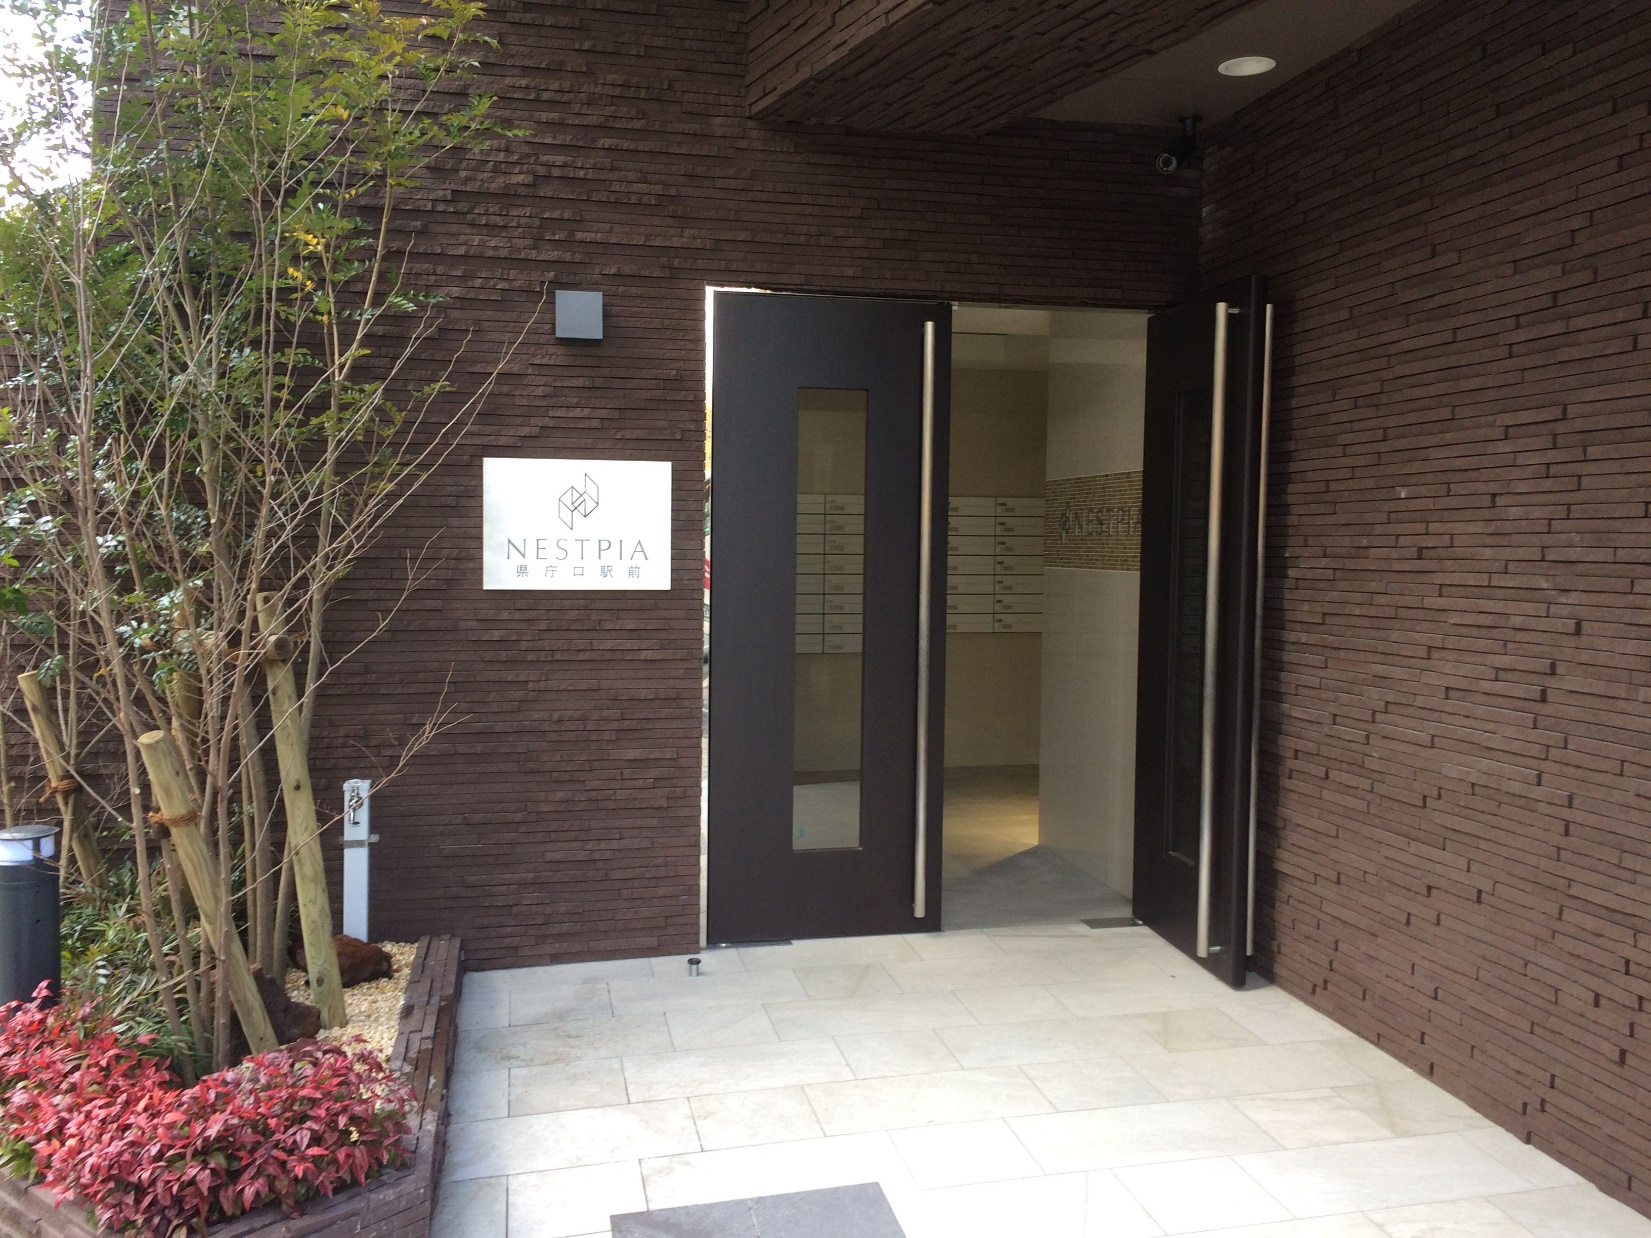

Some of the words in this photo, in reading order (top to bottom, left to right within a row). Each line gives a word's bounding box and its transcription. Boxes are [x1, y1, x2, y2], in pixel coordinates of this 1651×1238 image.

[507, 538, 649, 561] NESTPIA
[516, 564, 641, 578] 県庁口駅前
